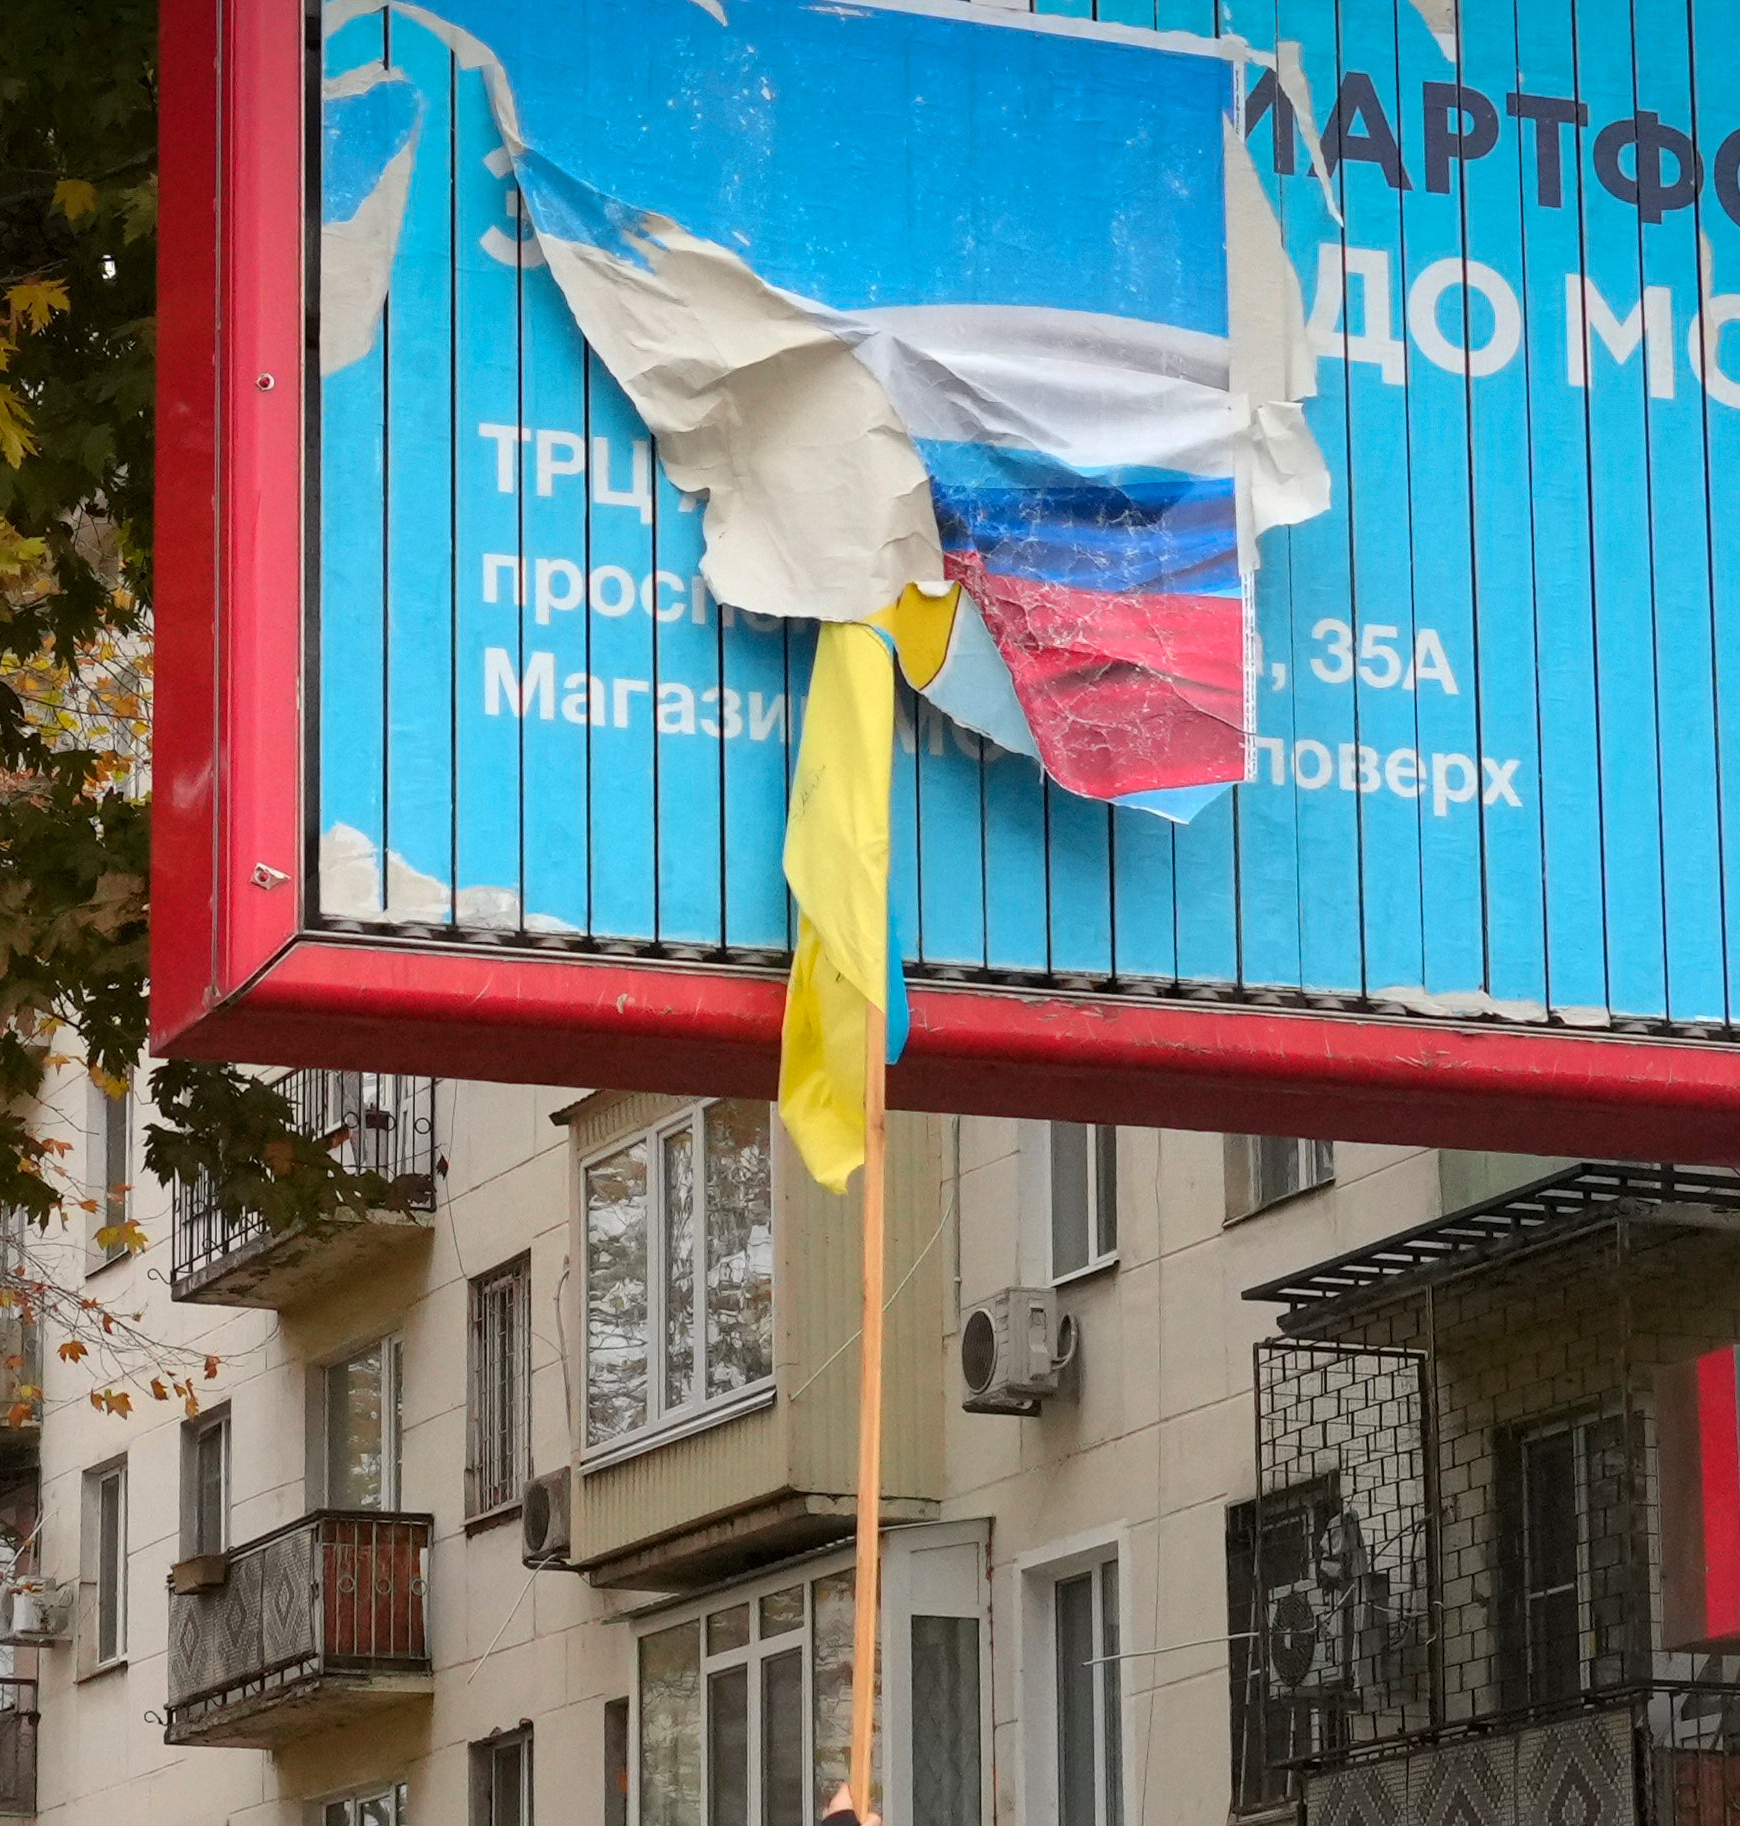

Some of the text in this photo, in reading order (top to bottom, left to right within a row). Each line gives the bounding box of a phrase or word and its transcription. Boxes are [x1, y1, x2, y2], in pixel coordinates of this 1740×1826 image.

[1307, 243, 1522, 386] ДО
[478, 422, 652, 524] ТРЦ
[1310, 618, 1459, 695] 35А
